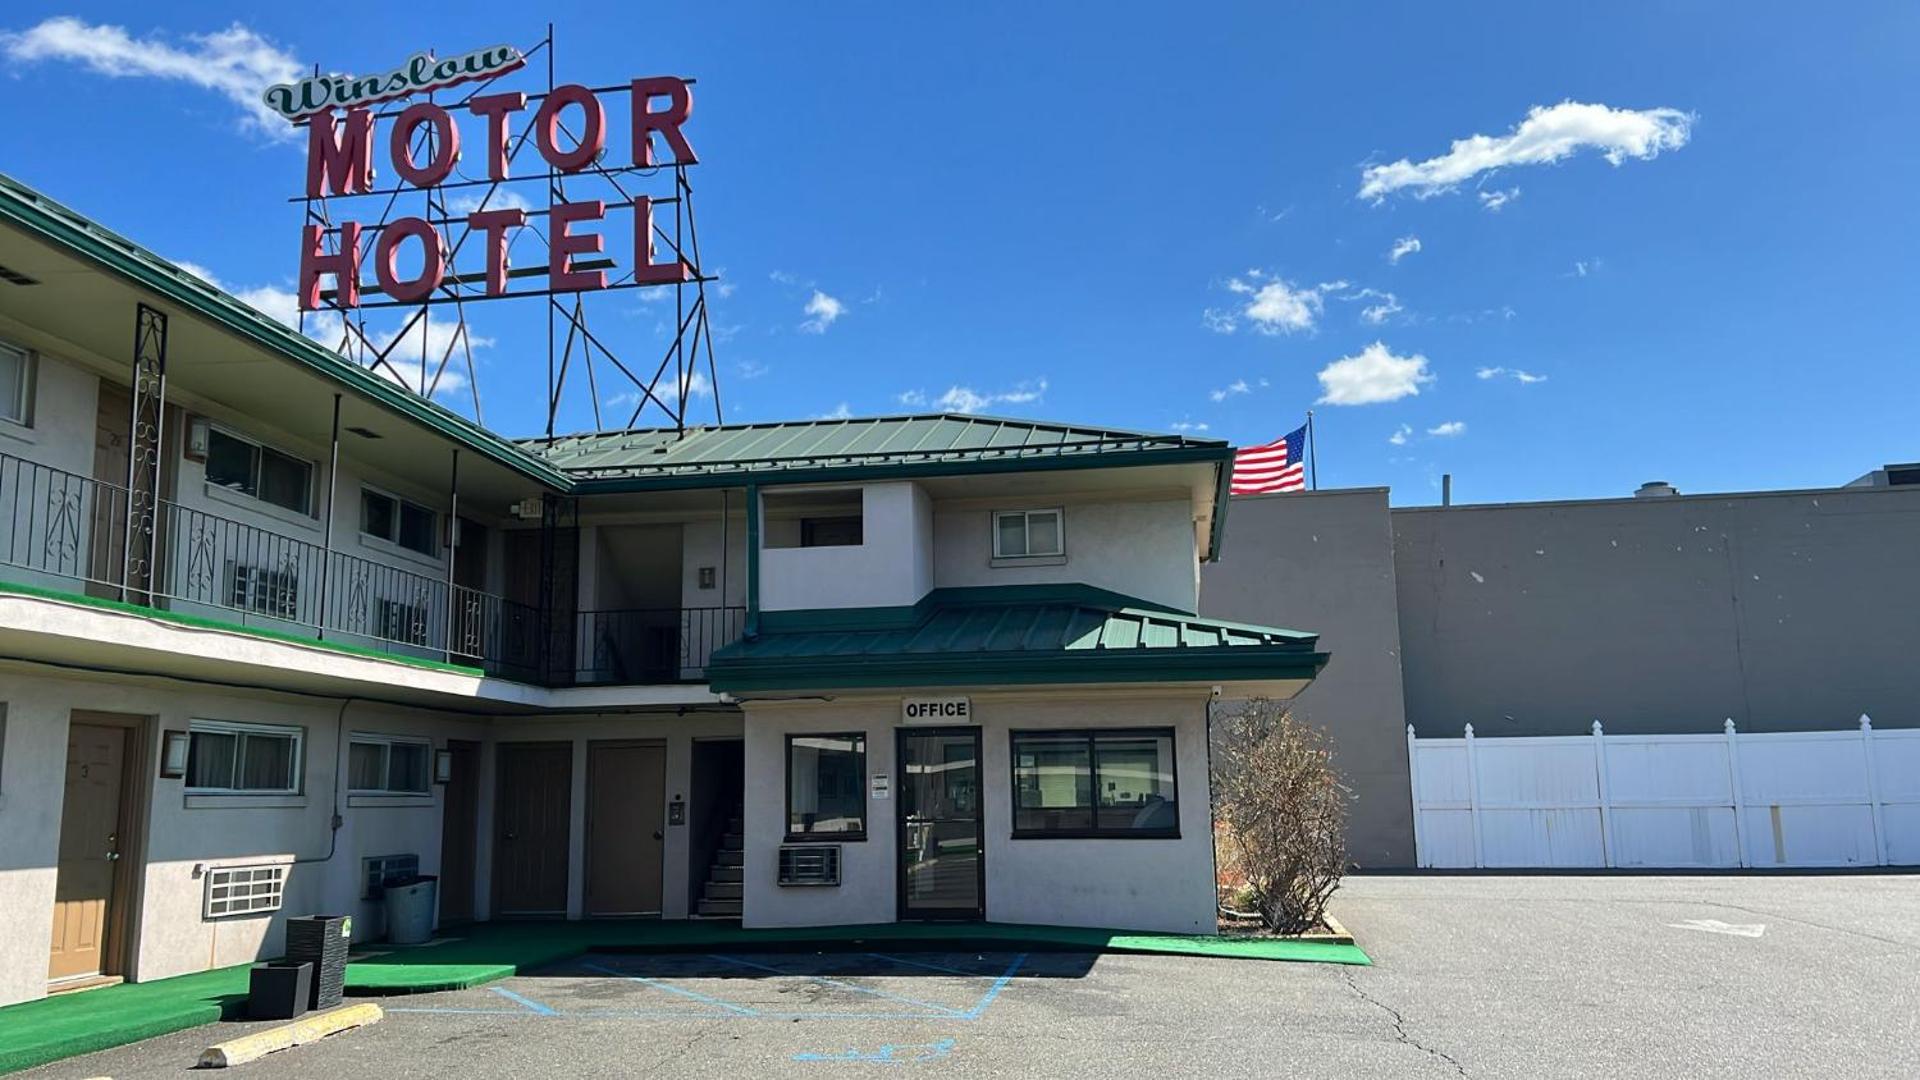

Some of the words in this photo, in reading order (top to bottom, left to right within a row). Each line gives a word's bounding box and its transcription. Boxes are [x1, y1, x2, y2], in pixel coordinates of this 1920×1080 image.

[267, 47, 515, 114] Winslow
[306, 76, 698, 198] MOTOR
[301, 196, 688, 310] HOTEL
[906, 702, 967, 717] OFFICE
